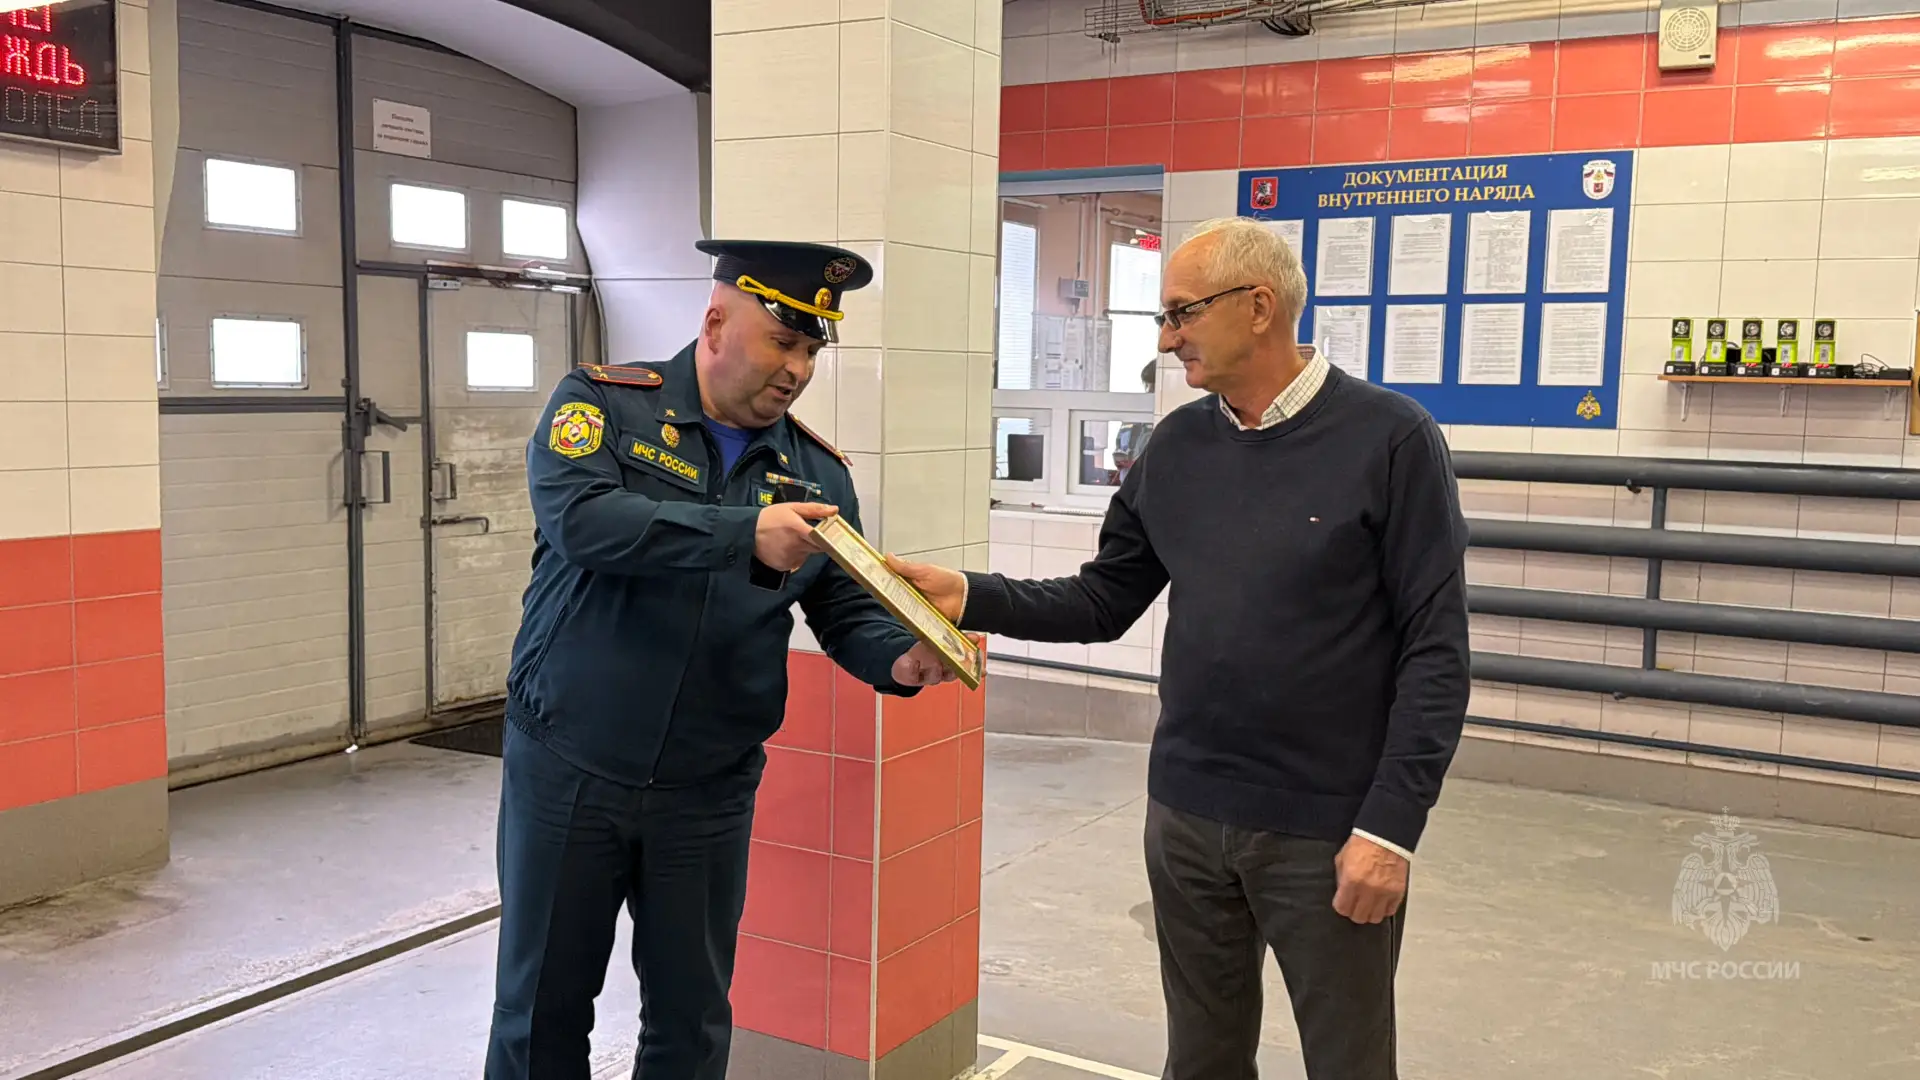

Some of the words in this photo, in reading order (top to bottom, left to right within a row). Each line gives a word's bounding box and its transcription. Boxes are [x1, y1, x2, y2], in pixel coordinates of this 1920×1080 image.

[1342, 164, 1509, 189] ДОКУМЕНТАЦИЯ
[1317, 188, 1450, 210] ВНУТРЕННЕГО
[1454, 184, 1536, 203] НАРЯДА
[633, 441, 656, 461] МЧС
[659, 452, 698, 480] РОССИИ
